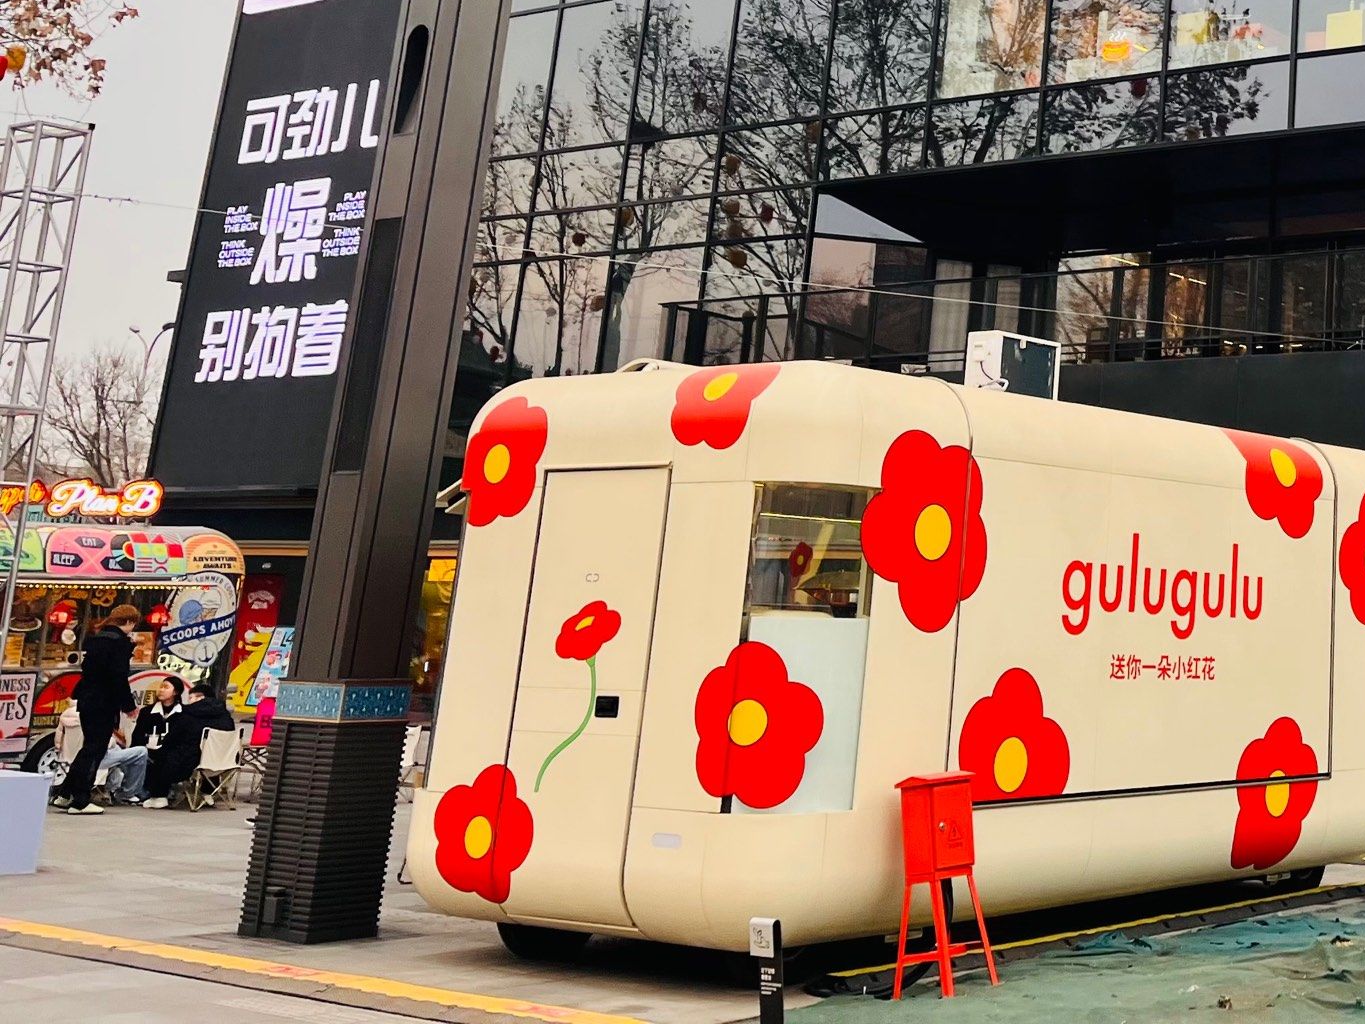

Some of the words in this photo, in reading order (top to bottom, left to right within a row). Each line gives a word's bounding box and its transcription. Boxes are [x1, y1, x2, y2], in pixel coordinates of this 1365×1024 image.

[237, 78, 380, 164] 可劲儿
[343, 190, 367, 202] PLAY
[226, 205, 249, 216] PLAY
[336, 200, 365, 212] INSIDE
[225, 213, 253, 225] INSIDE
[328, 211, 346, 222] THE
[346, 209, 365, 220] BOX
[224, 224, 240, 234] THE
[240, 221, 259, 232] BOX
[249, 177, 332, 285] 燥
[333, 226, 361, 238] THINK
[220, 239, 246, 250] THINK
[322, 236, 361, 249] OUTSIDE
[218, 247, 255, 259] OUTSIDE
[321, 247, 340, 258] THE
[340, 245, 359, 256] BOX
[217, 258, 234, 268] THE
[234, 256, 252, 267] BOX
[194, 299, 349, 383] 别拘着
[49, 479, 119, 516] Plan
[119, 480, 163, 516] B
[1061, 532, 1264, 640] gulugulu
[162, 624, 206, 645] SCOOPS
[1109, 653, 1216, 681] 送你一朵小红花
[0, 677, 31, 692] NESS
